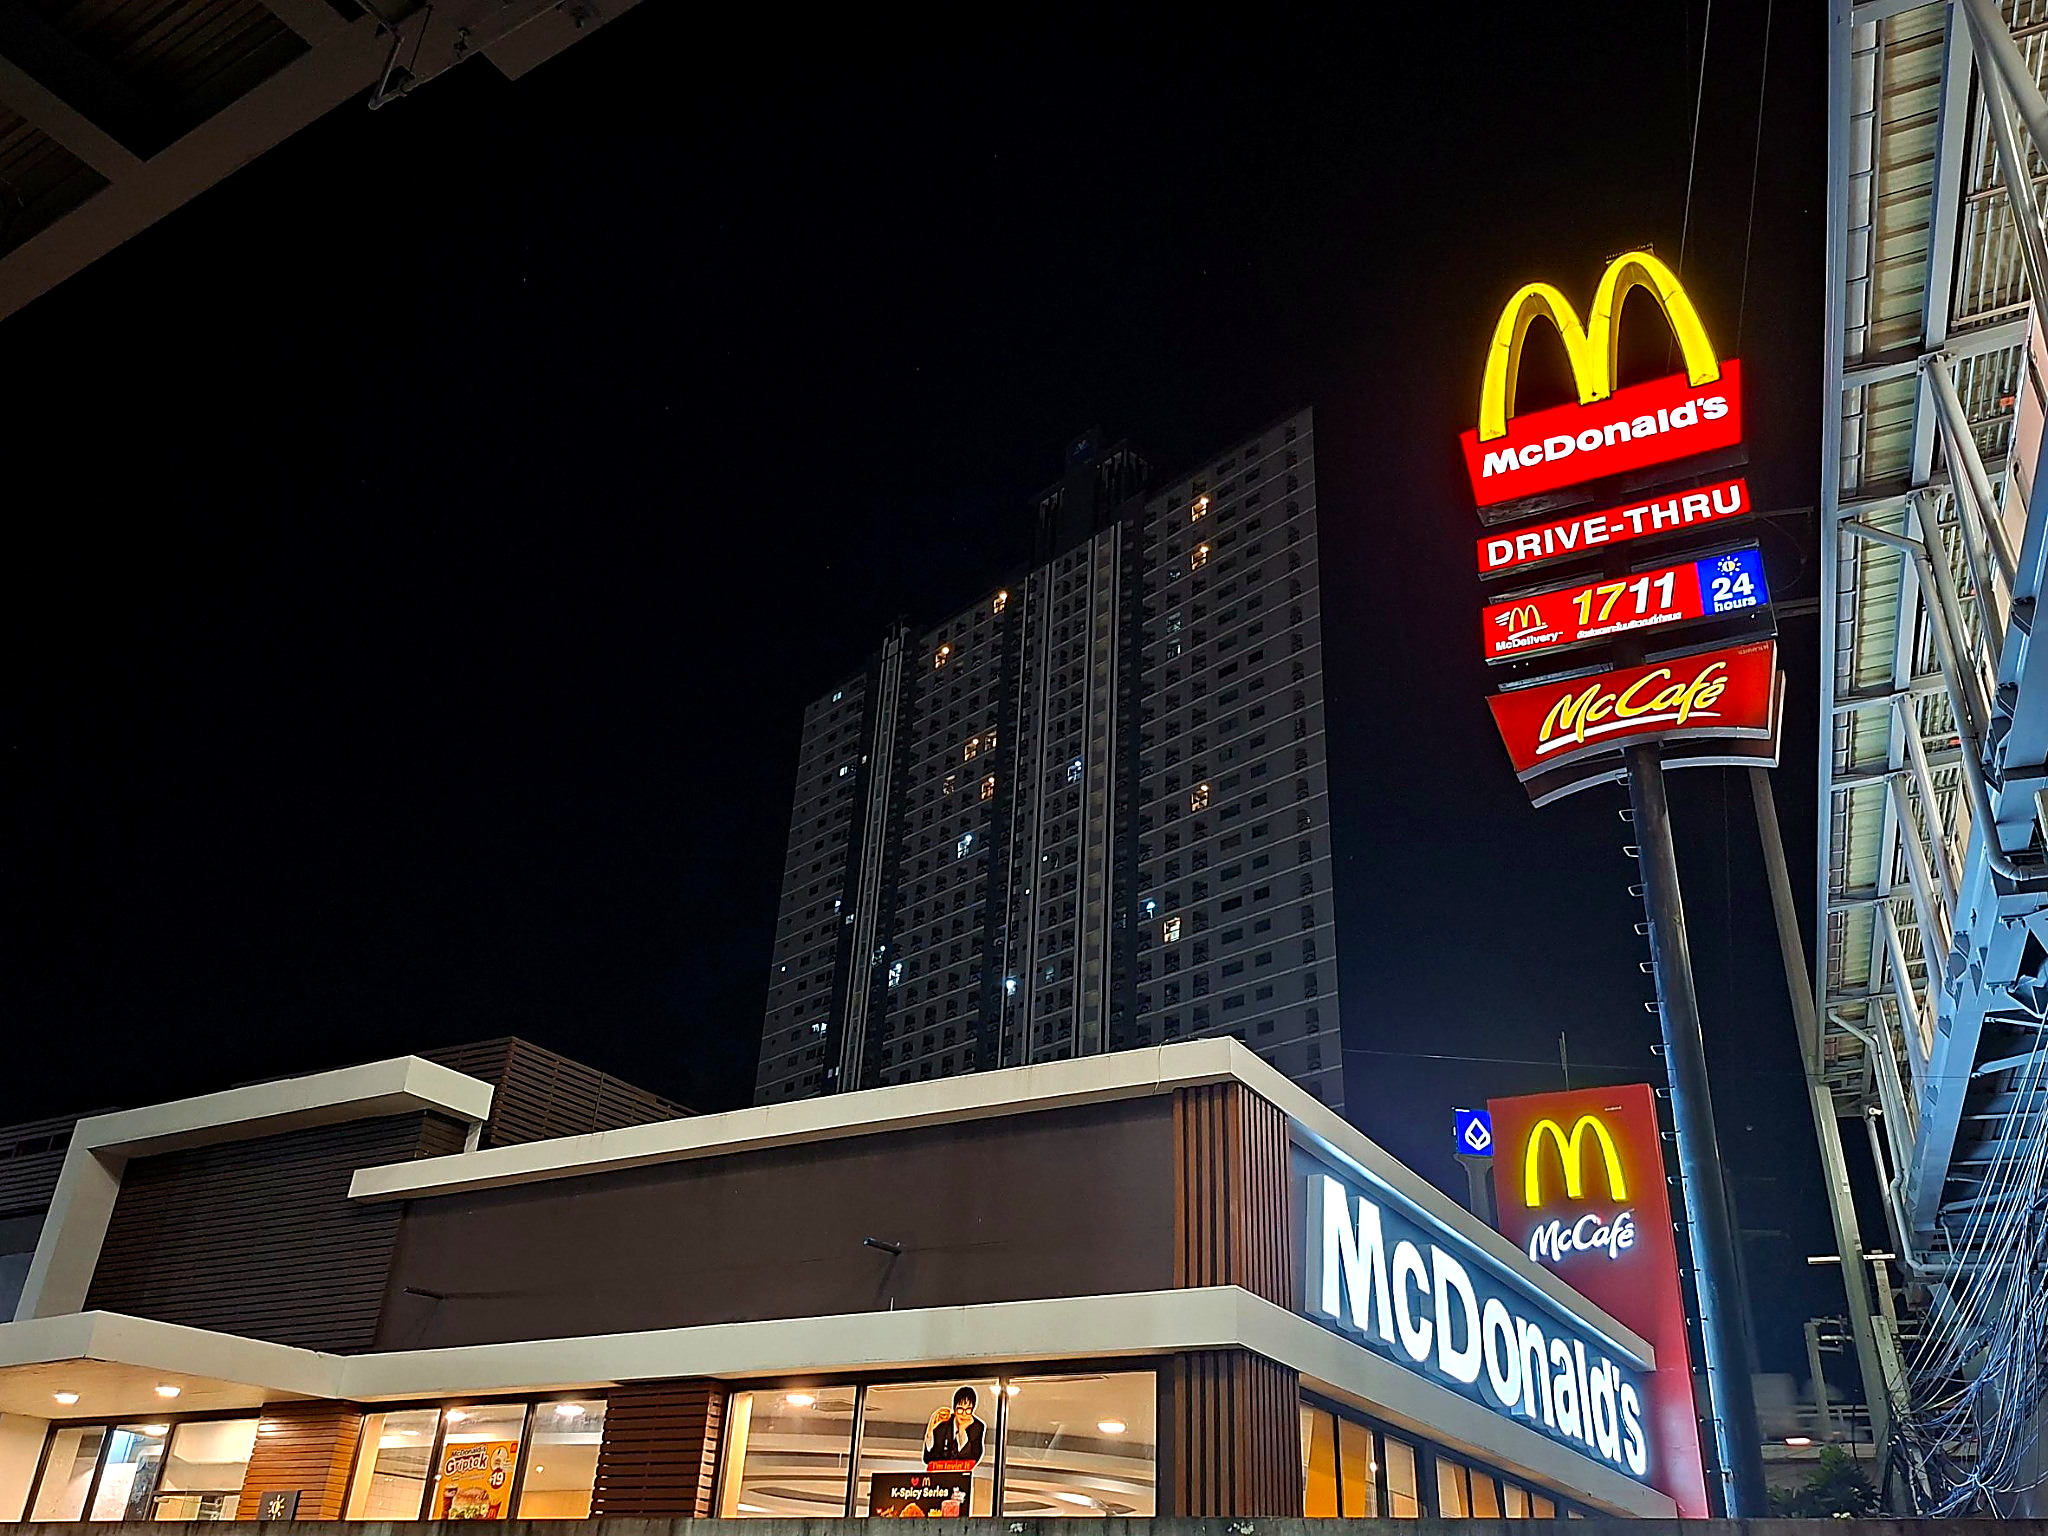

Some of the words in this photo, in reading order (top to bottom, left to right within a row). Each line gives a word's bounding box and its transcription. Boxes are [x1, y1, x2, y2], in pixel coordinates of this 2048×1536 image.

[1482, 396, 1728, 478] McDonald's
[1487, 484, 1742, 567] DRIVE-THRU
[1572, 571, 1675, 626] 1711
[1711, 572, 1755, 602] 24
[1714, 595, 1757, 613] hours
[1495, 631, 1559, 651] McDelivery
[1539, 661, 1729, 744] McCafé
[1529, 1211, 1636, 1262] McCafé
[1321, 1174, 1647, 1476] McDonald's
[446, 1453, 488, 1474] Griptok
[891, 1486, 922, 1500] K-Spicy
[922, 1485, 949, 1498] Series
